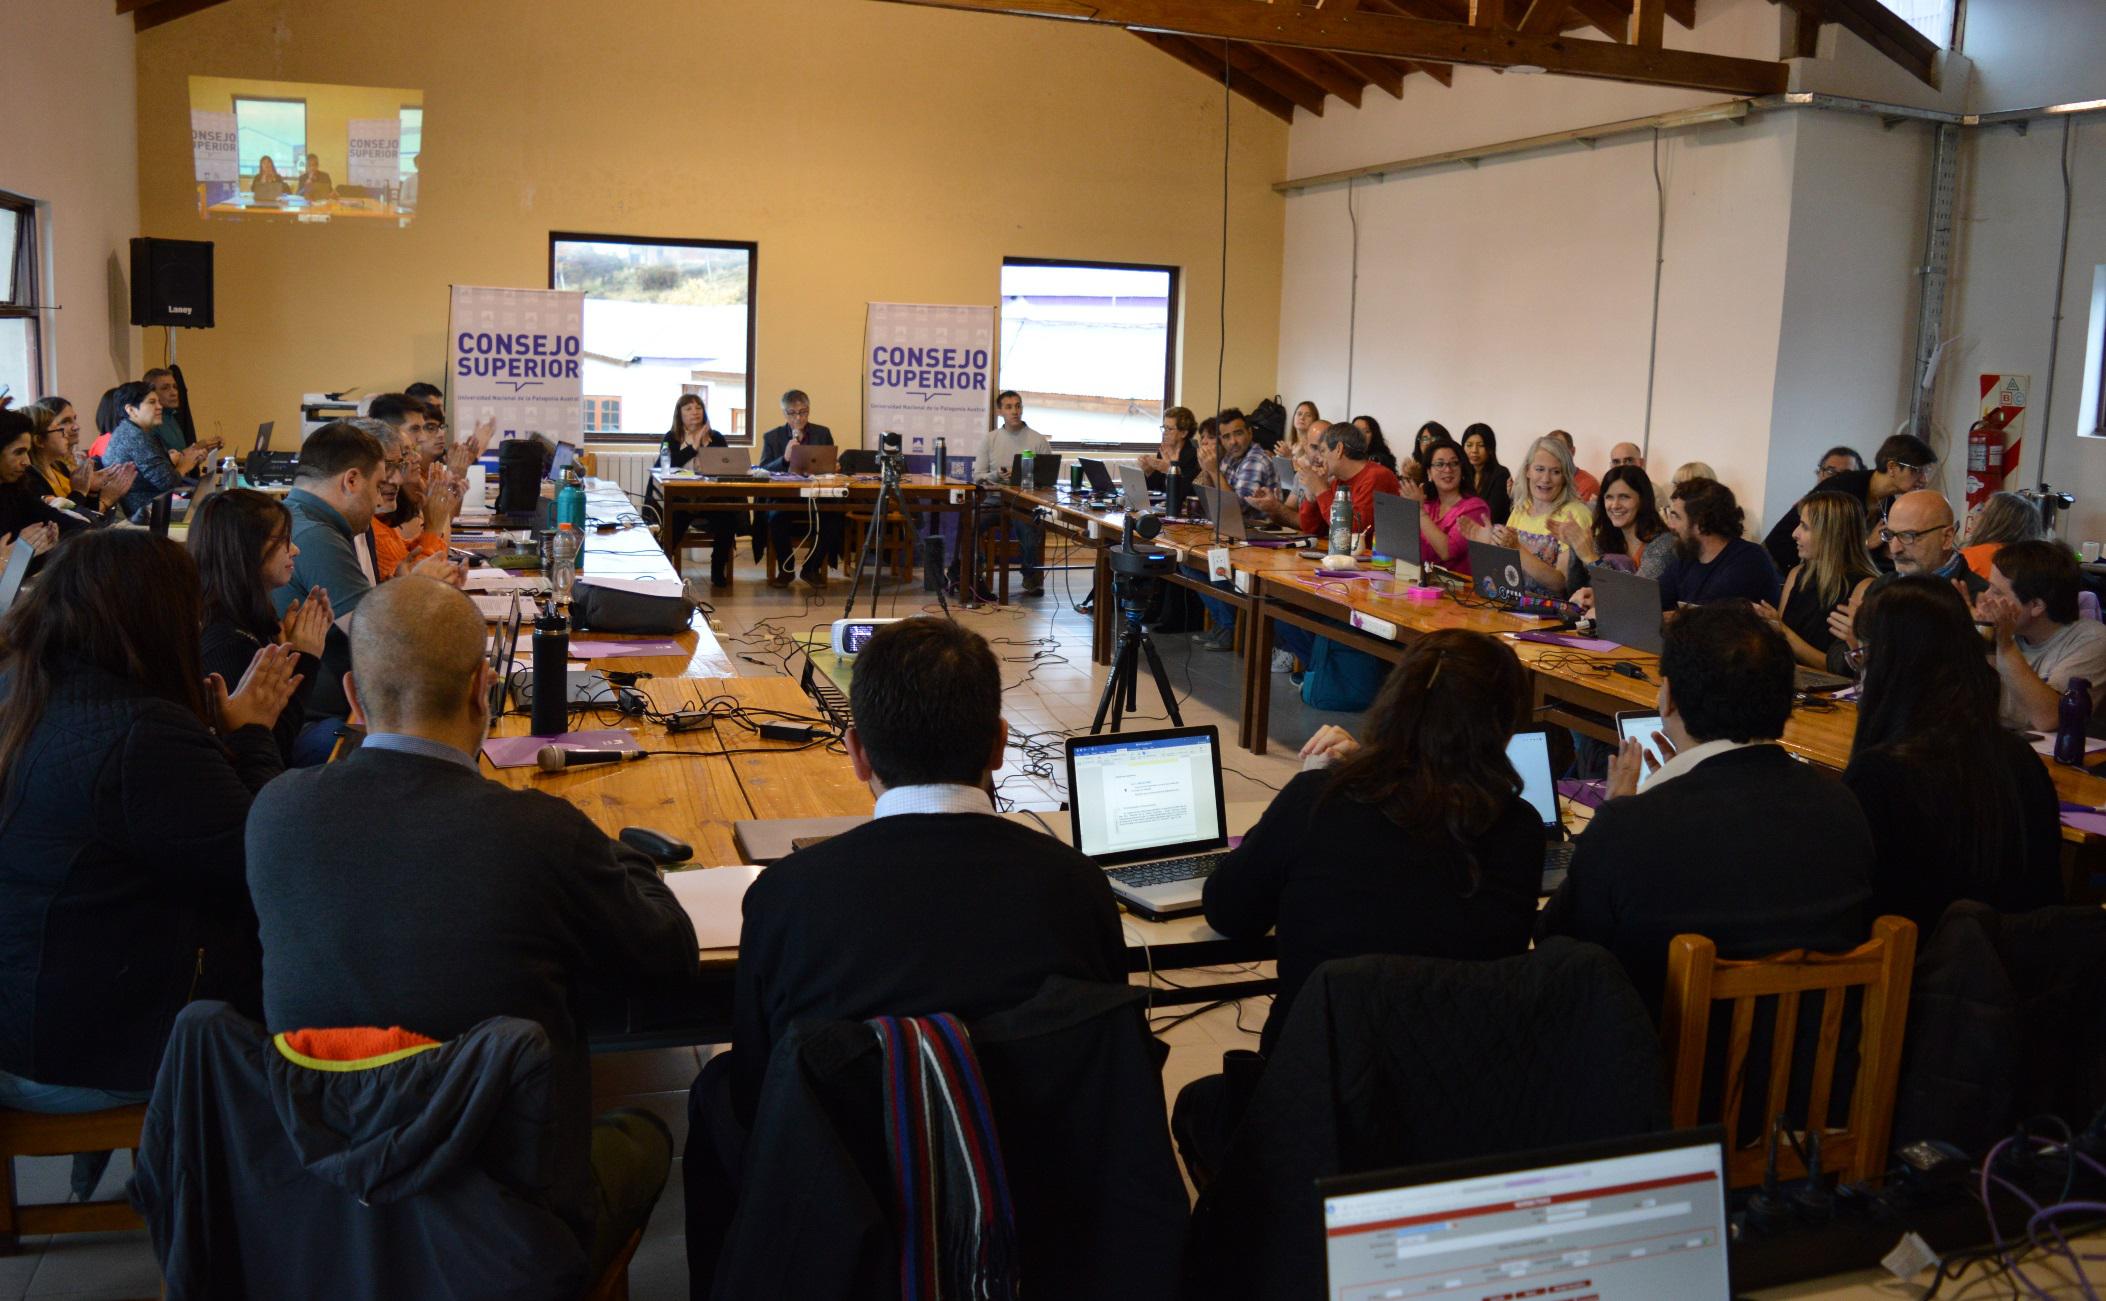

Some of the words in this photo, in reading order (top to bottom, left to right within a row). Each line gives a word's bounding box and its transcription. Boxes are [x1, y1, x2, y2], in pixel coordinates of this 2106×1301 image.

[192, 129, 236, 142] ONSEJO
[350, 138, 399, 149] CONSEJO
[350, 149, 398, 159] SUPERIOR
[168, 305, 192, 315] Laney
[458, 332, 580, 356] CONSEJO
[873, 346, 988, 370] CONSEJO
[458, 356, 579, 379] SUPERIOR
[872, 368, 986, 391] SUPERIOR
